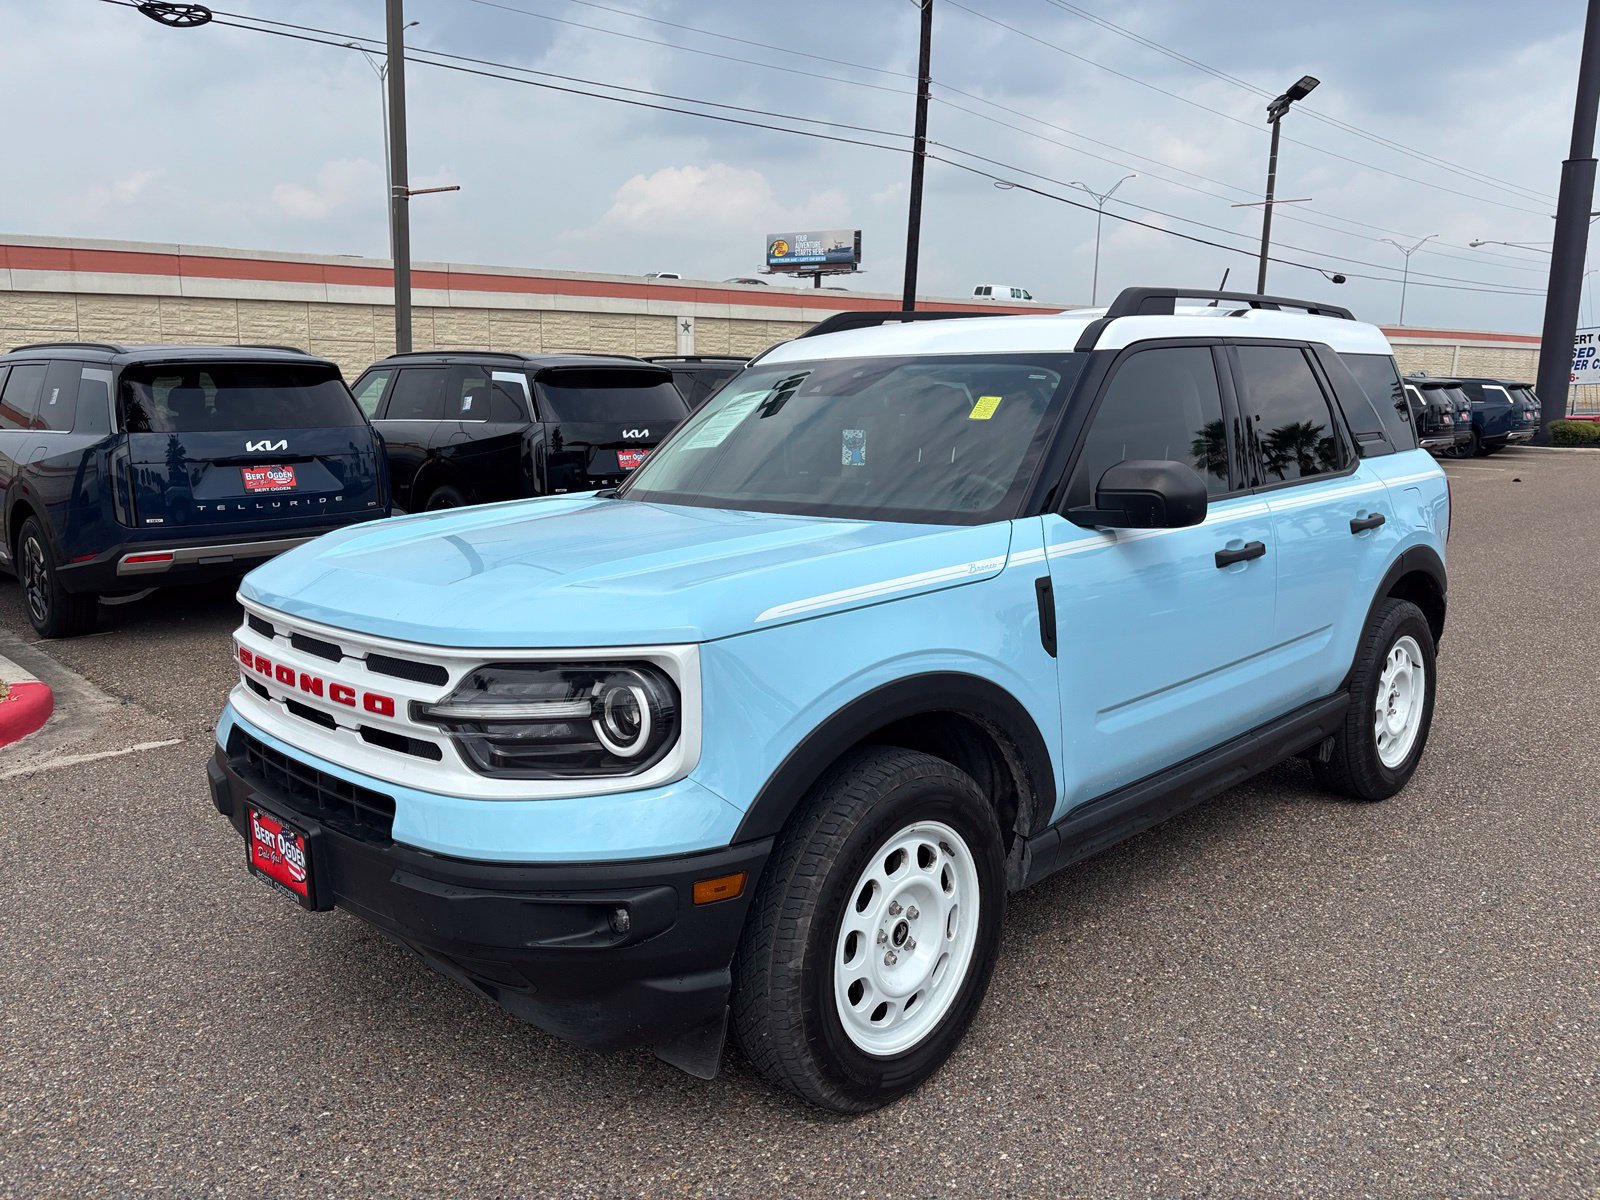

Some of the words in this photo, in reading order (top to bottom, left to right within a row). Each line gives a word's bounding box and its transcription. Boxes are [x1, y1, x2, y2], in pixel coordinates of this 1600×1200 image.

[795, 241, 822, 249] ADVENTURE
[795, 249, 812, 257] STARTS
[813, 248, 825, 256] HERE
[1574, 333, 1594, 345] ERT
[1572, 347, 1596, 359] SED
[622, 429, 649, 438] KIA
[245, 439, 288, 452] KIA
[245, 472, 266, 481] BERT
[266, 470, 293, 480] OGDEN
[197, 495, 344, 511] TELLURIDE
[239, 647, 395, 718] BRONCO
[253, 819, 276, 850] BERT
[277, 833, 306, 868] OGDEN
[255, 870, 273, 887] BERT
[274, 881, 300, 904] OGDEN
